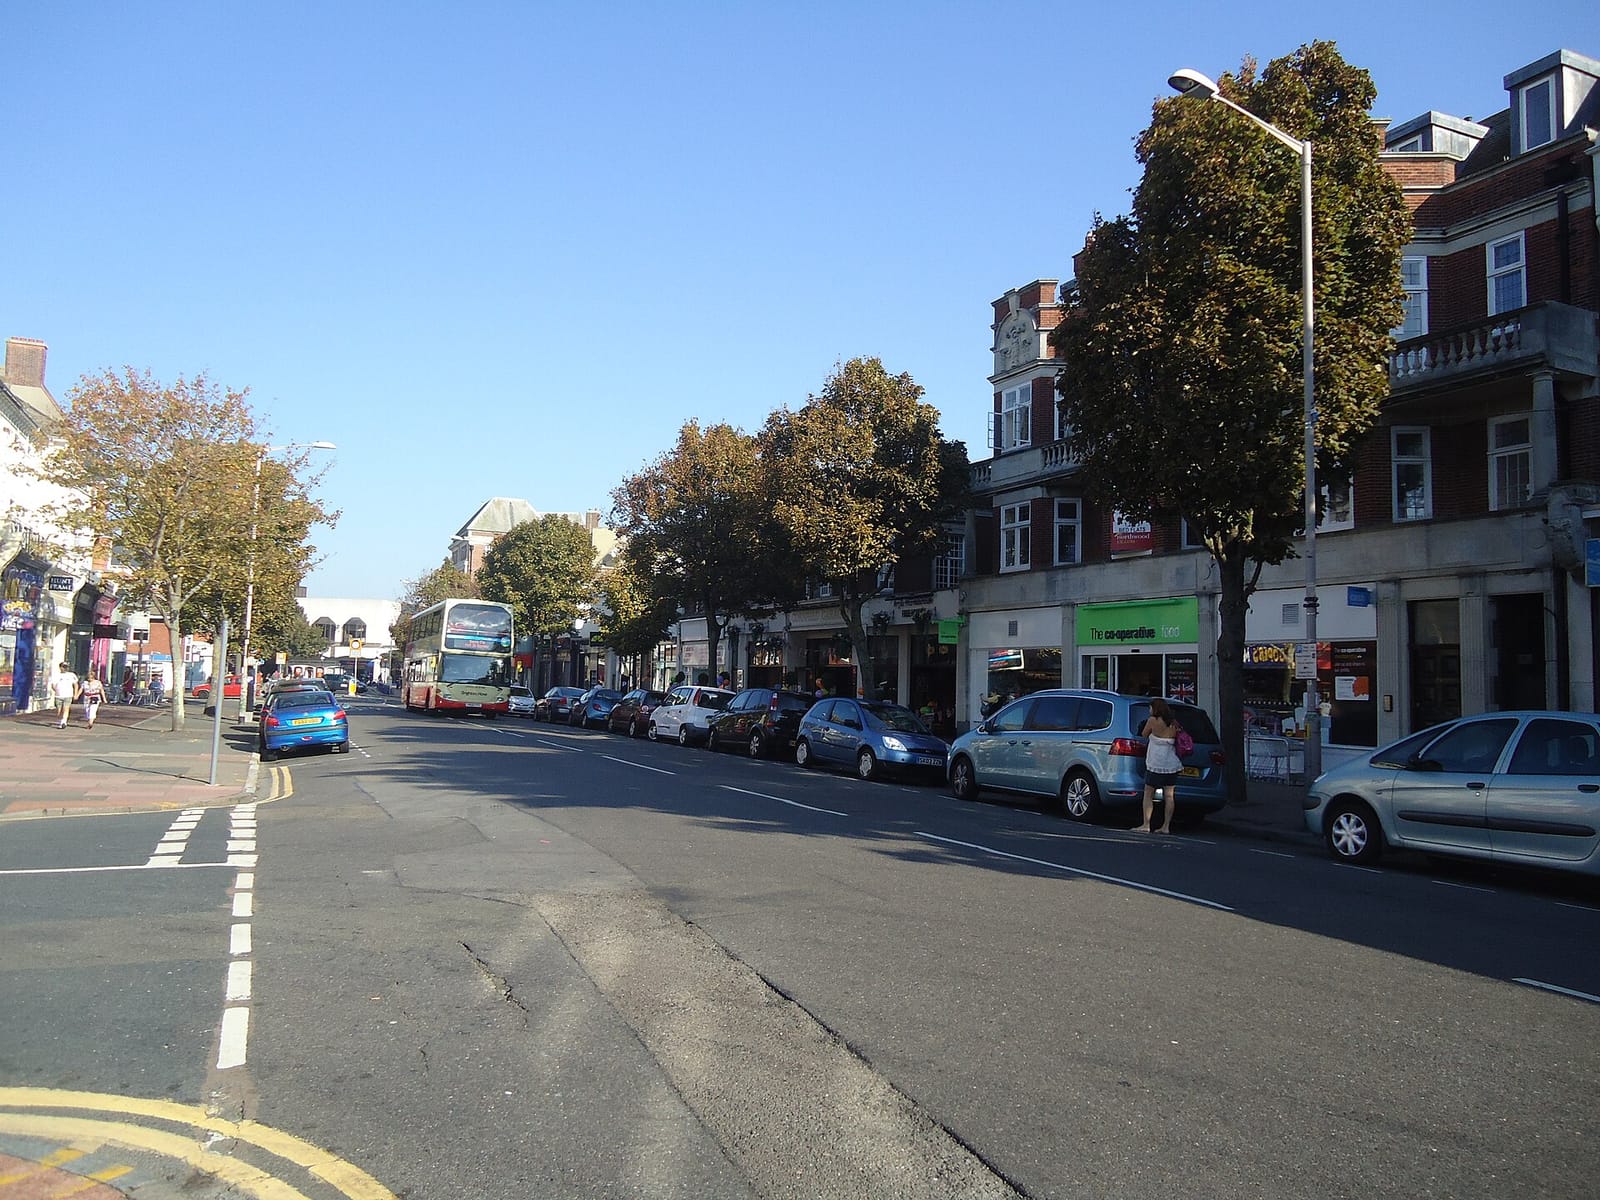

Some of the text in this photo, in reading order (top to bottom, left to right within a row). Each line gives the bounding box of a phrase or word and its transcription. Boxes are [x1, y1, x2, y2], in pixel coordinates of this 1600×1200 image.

[1090, 625, 1180, 641] The co-operative food
